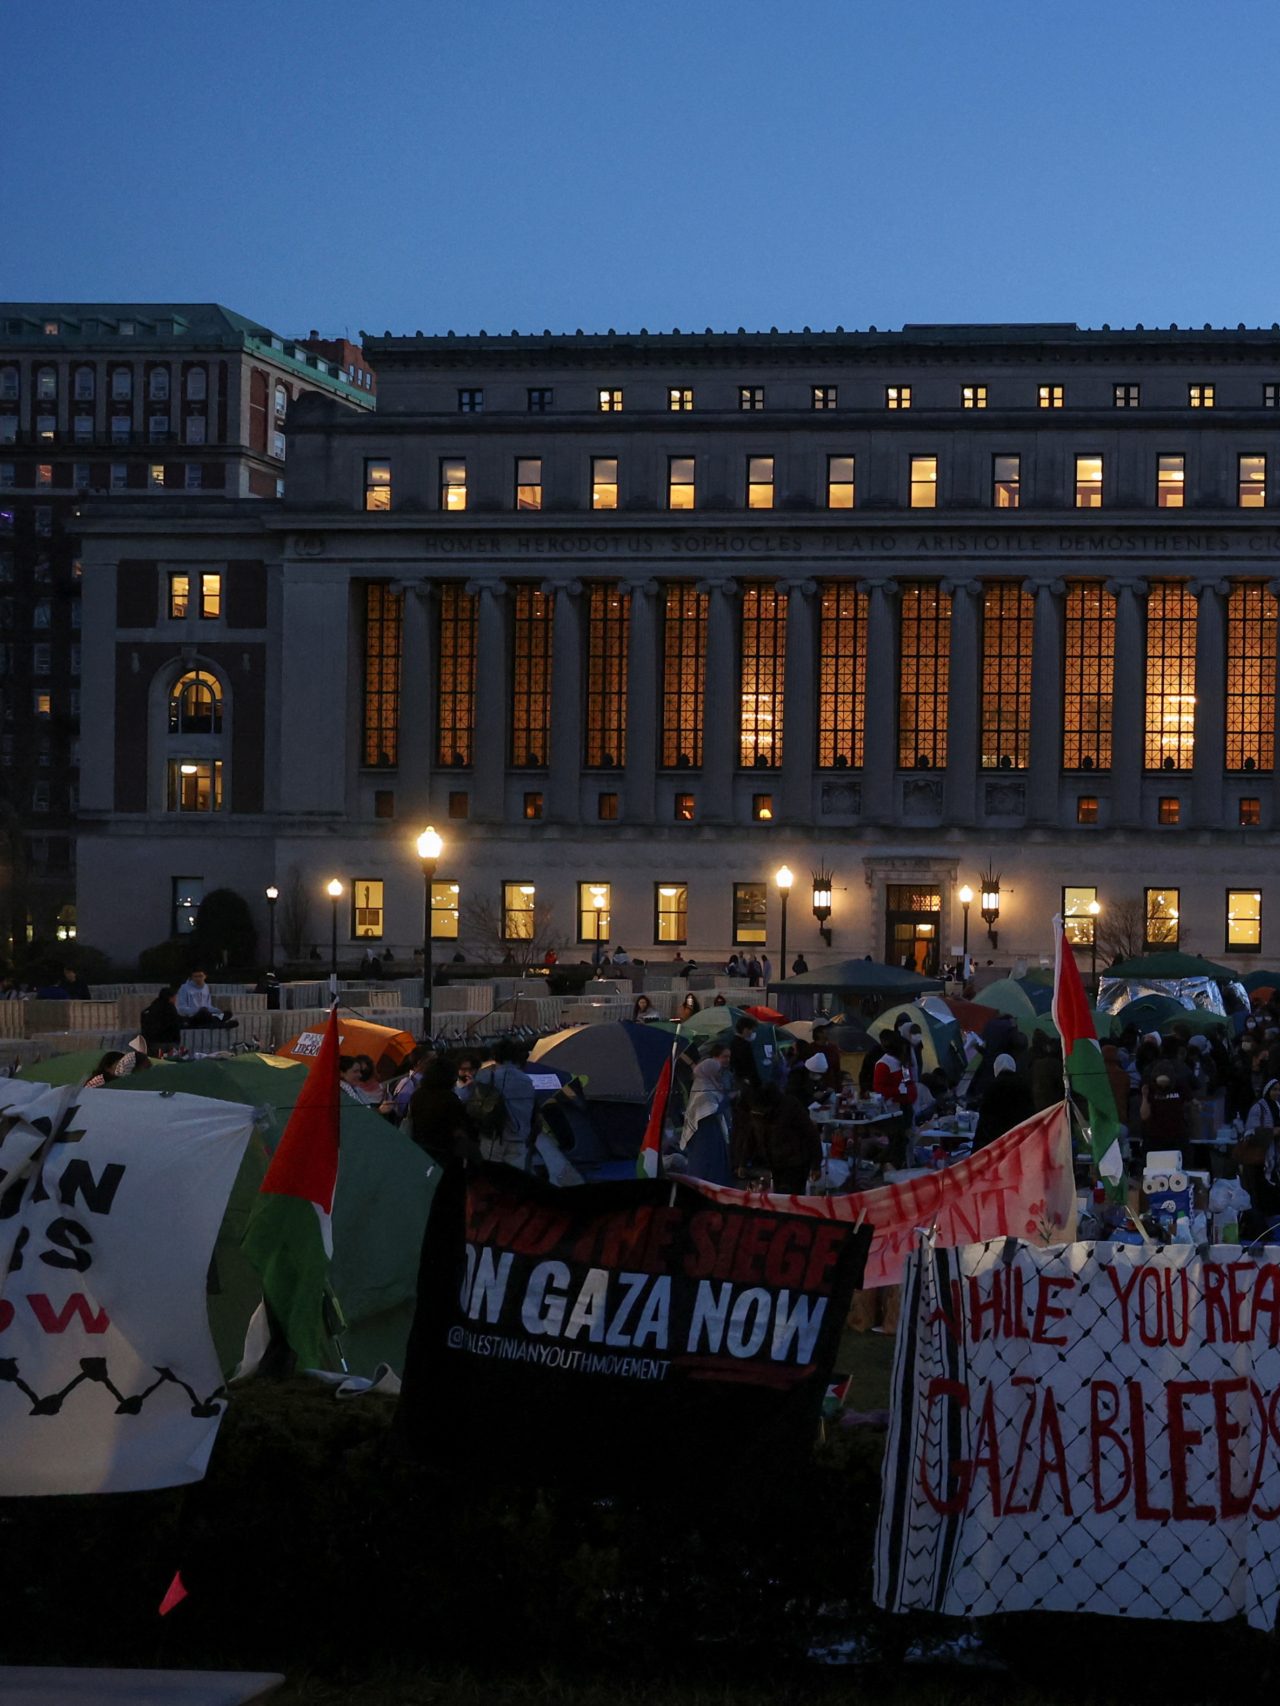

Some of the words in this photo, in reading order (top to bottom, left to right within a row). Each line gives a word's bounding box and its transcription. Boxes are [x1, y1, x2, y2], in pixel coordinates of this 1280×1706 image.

[425, 536, 502, 553] HOMER
[518, 536, 655, 553] HERODOTUS
[671, 535, 803, 553] SOPHOCLES
[822, 535, 897, 552] PLATO
[916, 535, 1043, 552] ARISTOTLE
[1058, 535, 1231, 553] DEMOSTHENES
[682, 1209, 848, 1294] SIEGE
[520, 1259, 673, 1351] GAZA
[686, 1279, 829, 1366] NOW
[1104, 1263, 1191, 1348] YOU
[447, 1325, 671, 1382] @LESTINIANYOUTHMOVEMENT
[920, 1376, 1075, 1518] GAZA
